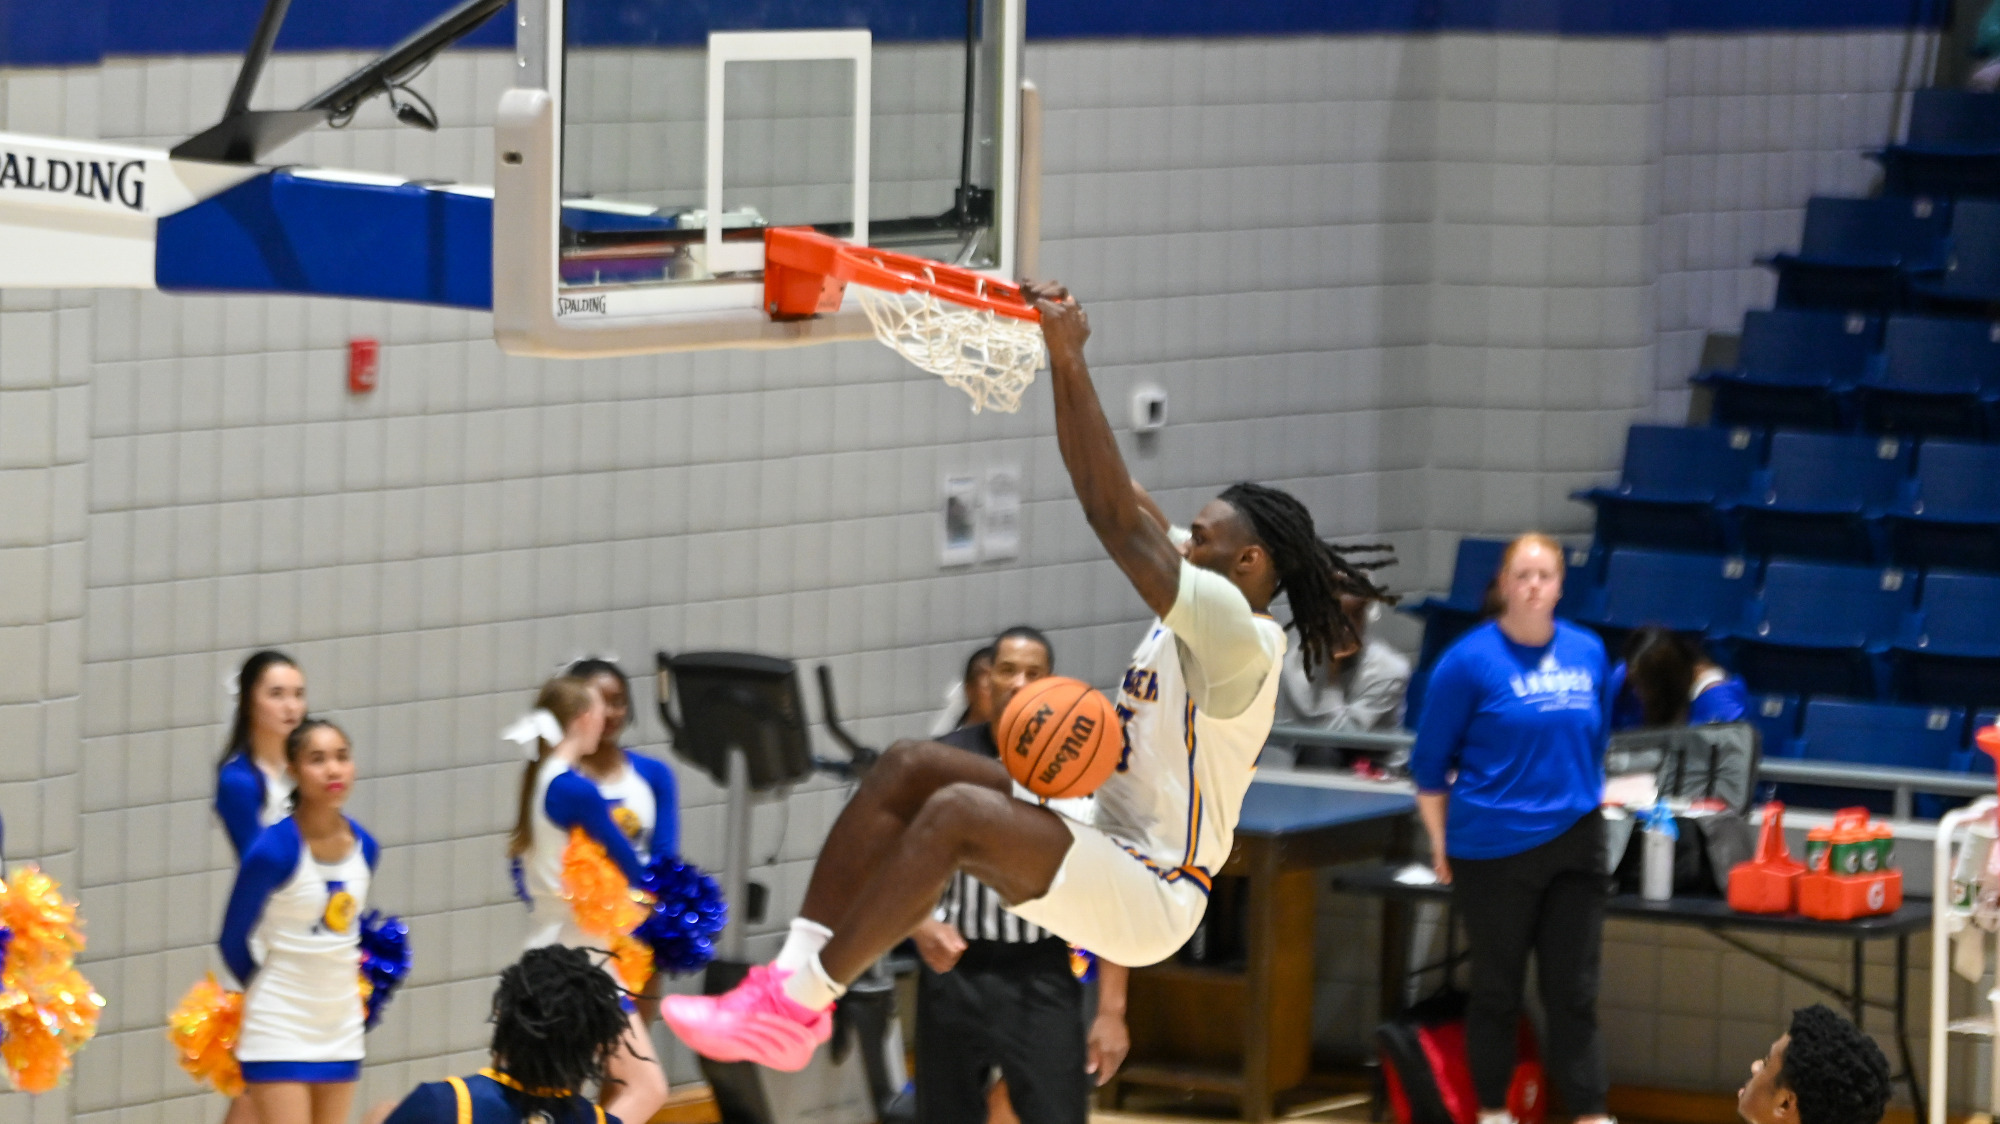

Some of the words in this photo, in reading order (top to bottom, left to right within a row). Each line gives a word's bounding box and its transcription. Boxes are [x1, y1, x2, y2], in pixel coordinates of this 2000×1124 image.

[0, 152, 145, 210] ALDING
[557, 295, 606, 317] SPALDING
[1038, 715, 1096, 784] Wilson
